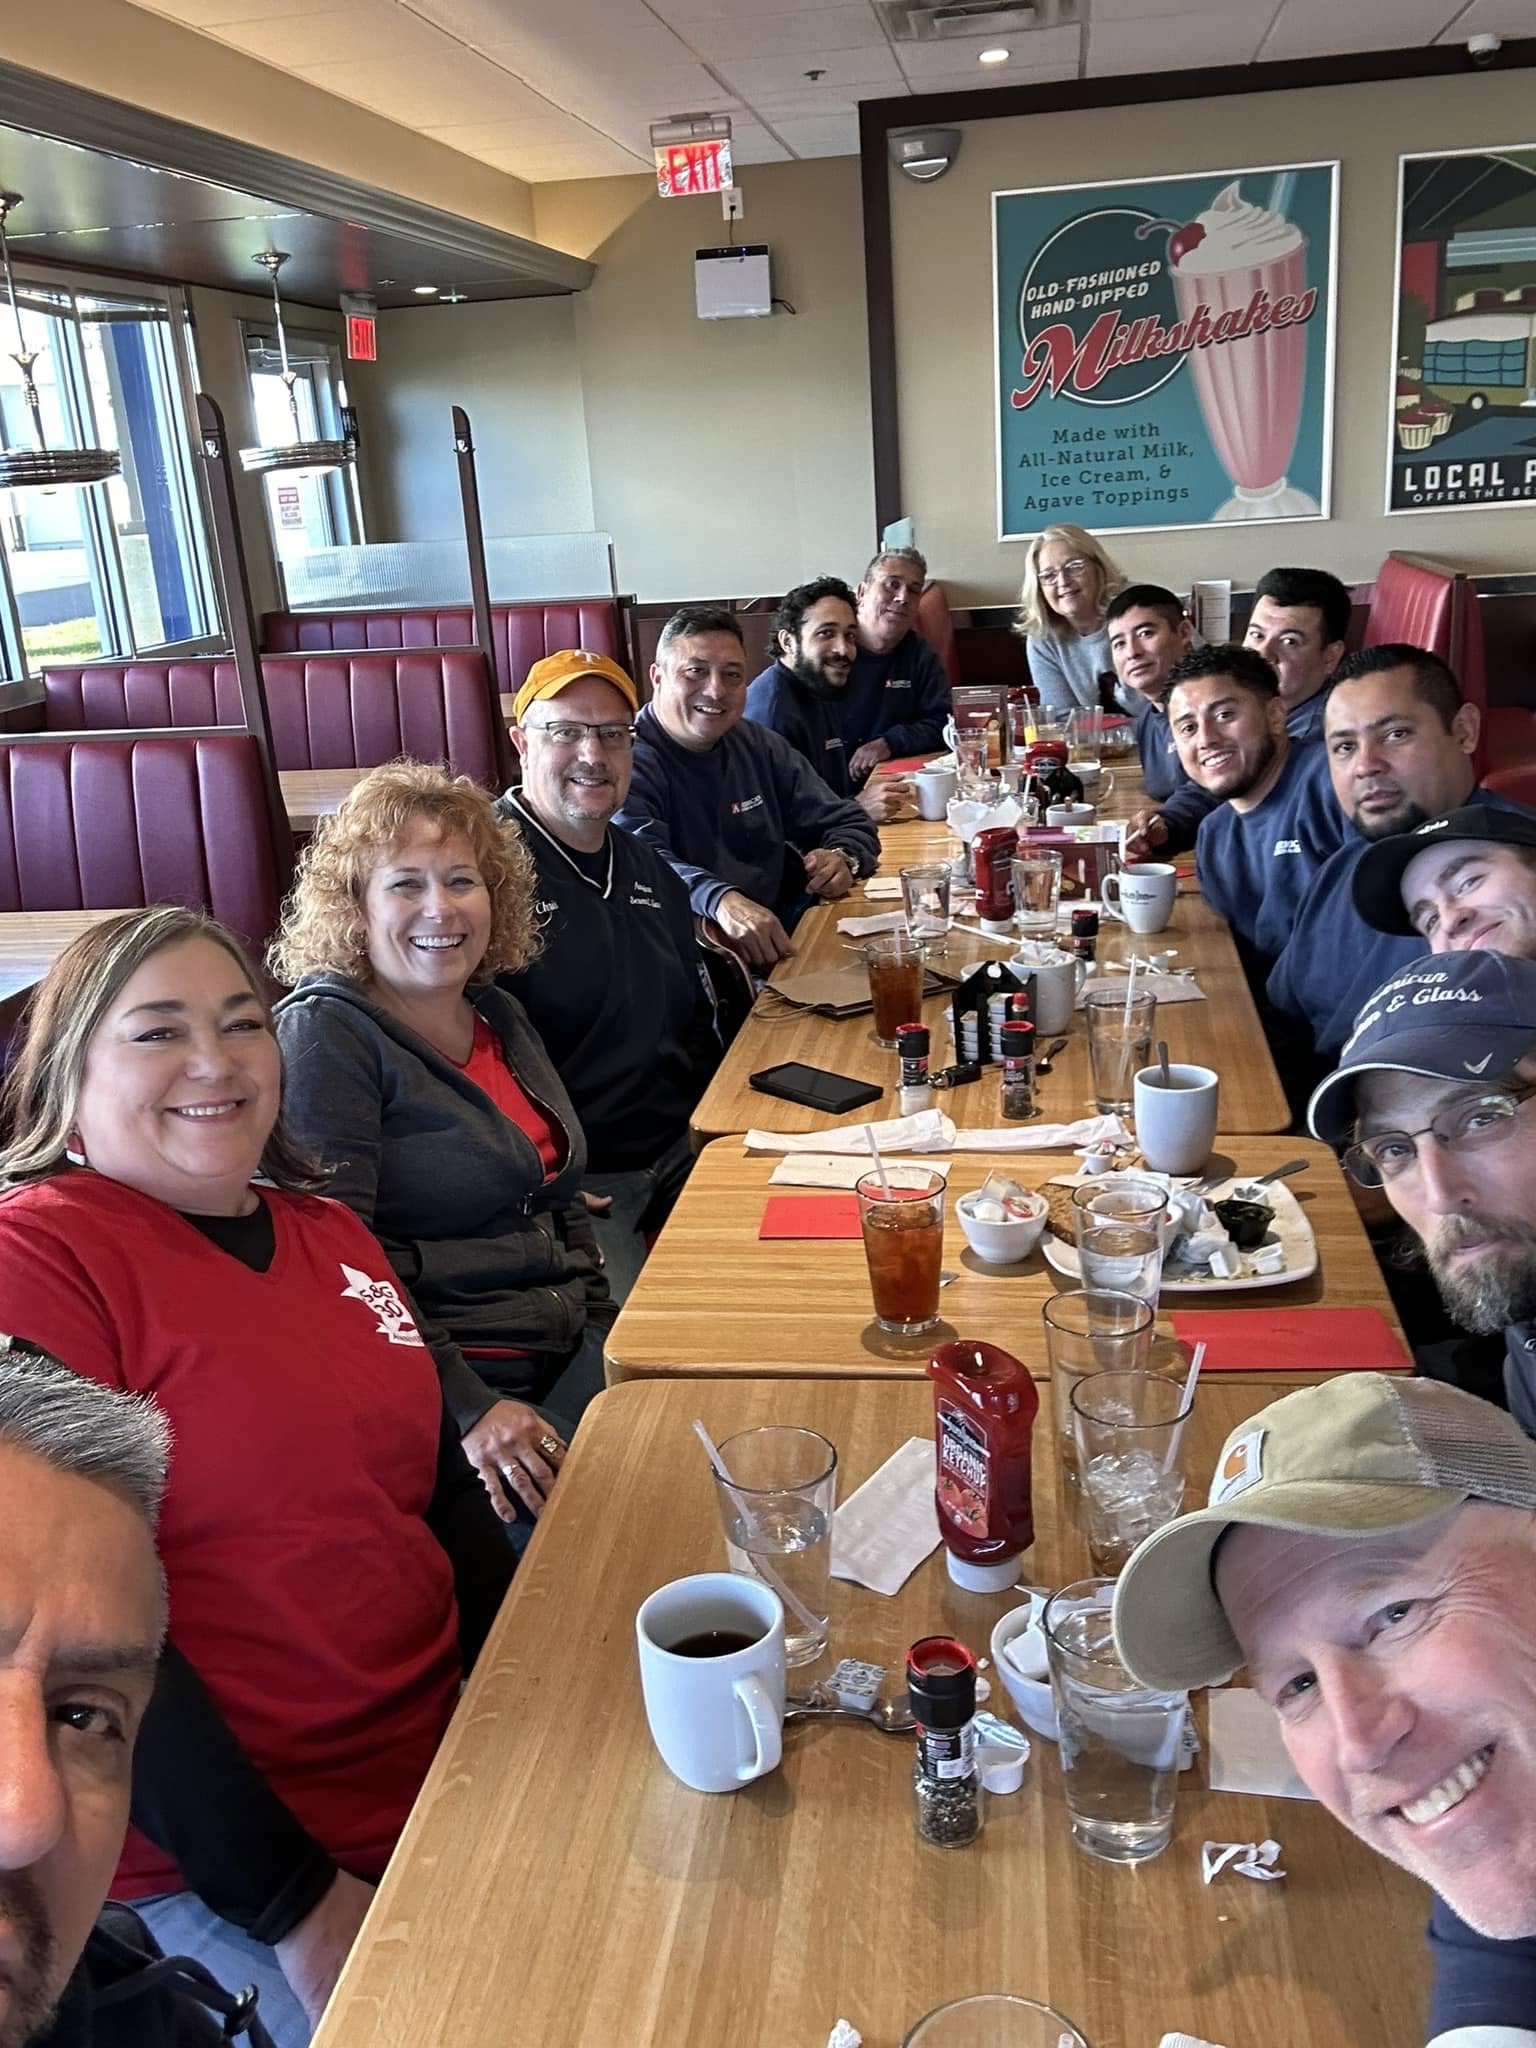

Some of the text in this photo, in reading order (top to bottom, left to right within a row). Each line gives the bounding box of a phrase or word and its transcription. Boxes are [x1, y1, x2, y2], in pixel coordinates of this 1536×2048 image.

[667, 143, 721, 194] EXIT
[1026, 260, 1162, 302] OLD-FASHIONED
[1031, 282, 1149, 319] HAND-DIPPED
[1011, 287, 1317, 409] Milkshakes
[1052, 422, 1160, 444] Made with
[1019, 442, 1194, 468] All-Natural Milk,
[1041, 464, 1171, 488] Ice Cream, &
[1404, 462, 1505, 492] LOCAL
[1024, 487, 1190, 512] Agave Toppings
[1413, 486, 1536, 502] OFFER THE BE
[1358, 971, 1448, 1020] rican
[1385, 986, 1482, 1013] & Glass
[942, 1448, 987, 1488] KETCHUP
